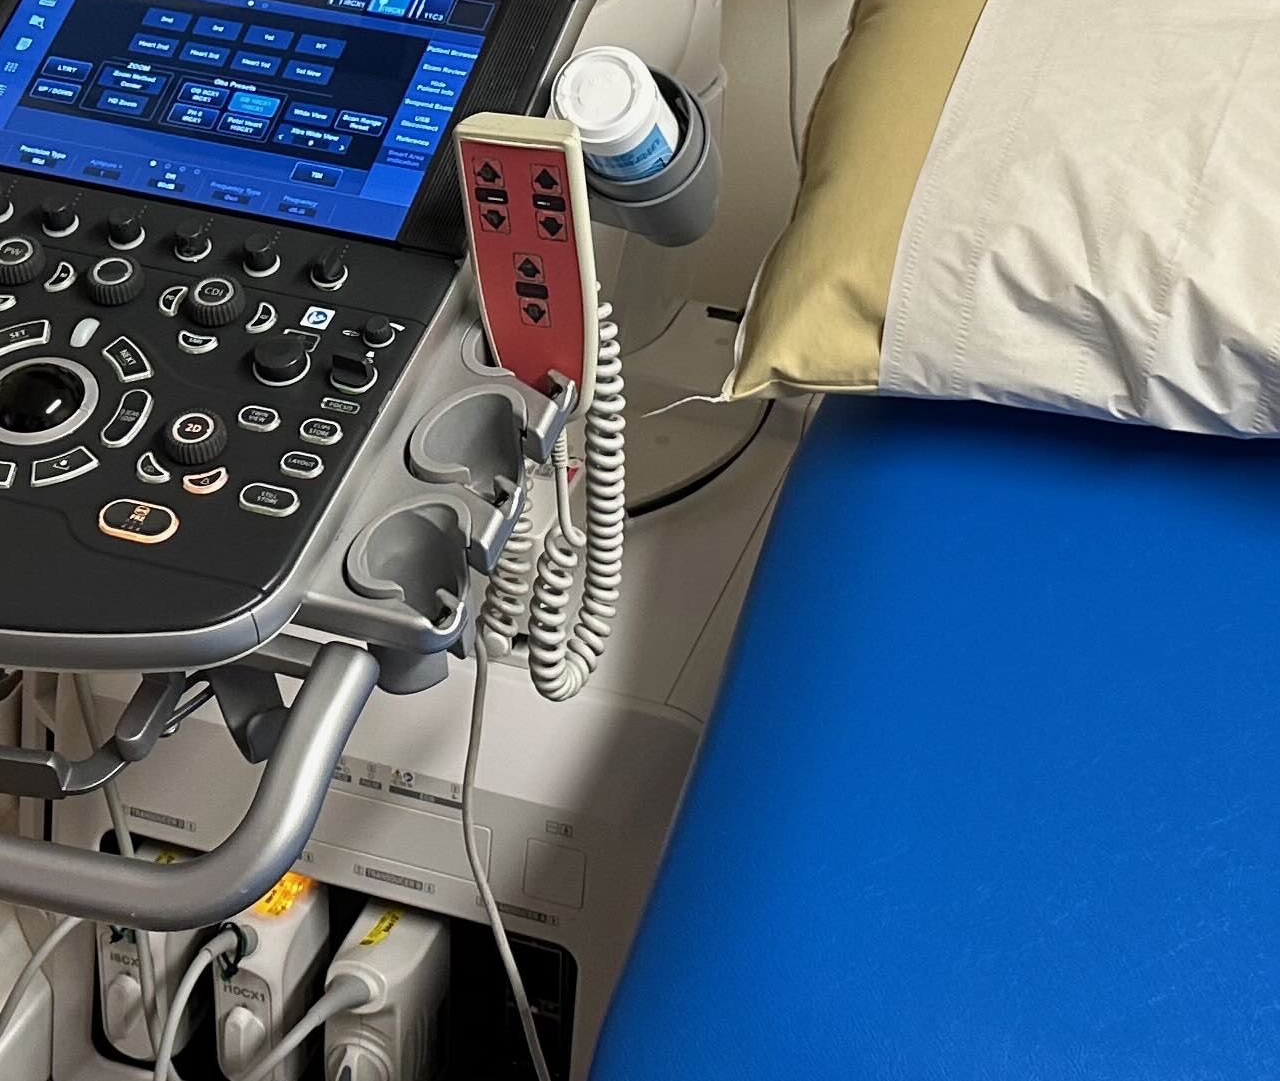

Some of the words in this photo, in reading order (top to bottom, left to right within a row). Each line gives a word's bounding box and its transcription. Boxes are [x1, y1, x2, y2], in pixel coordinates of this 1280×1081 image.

[204, 287, 224, 297] CDI
[9, 329, 26, 339] SET
[119, 348, 137, 366] NEXT
[185, 423, 203, 433] 2D
[287, 458, 316, 468] LAYOUT
